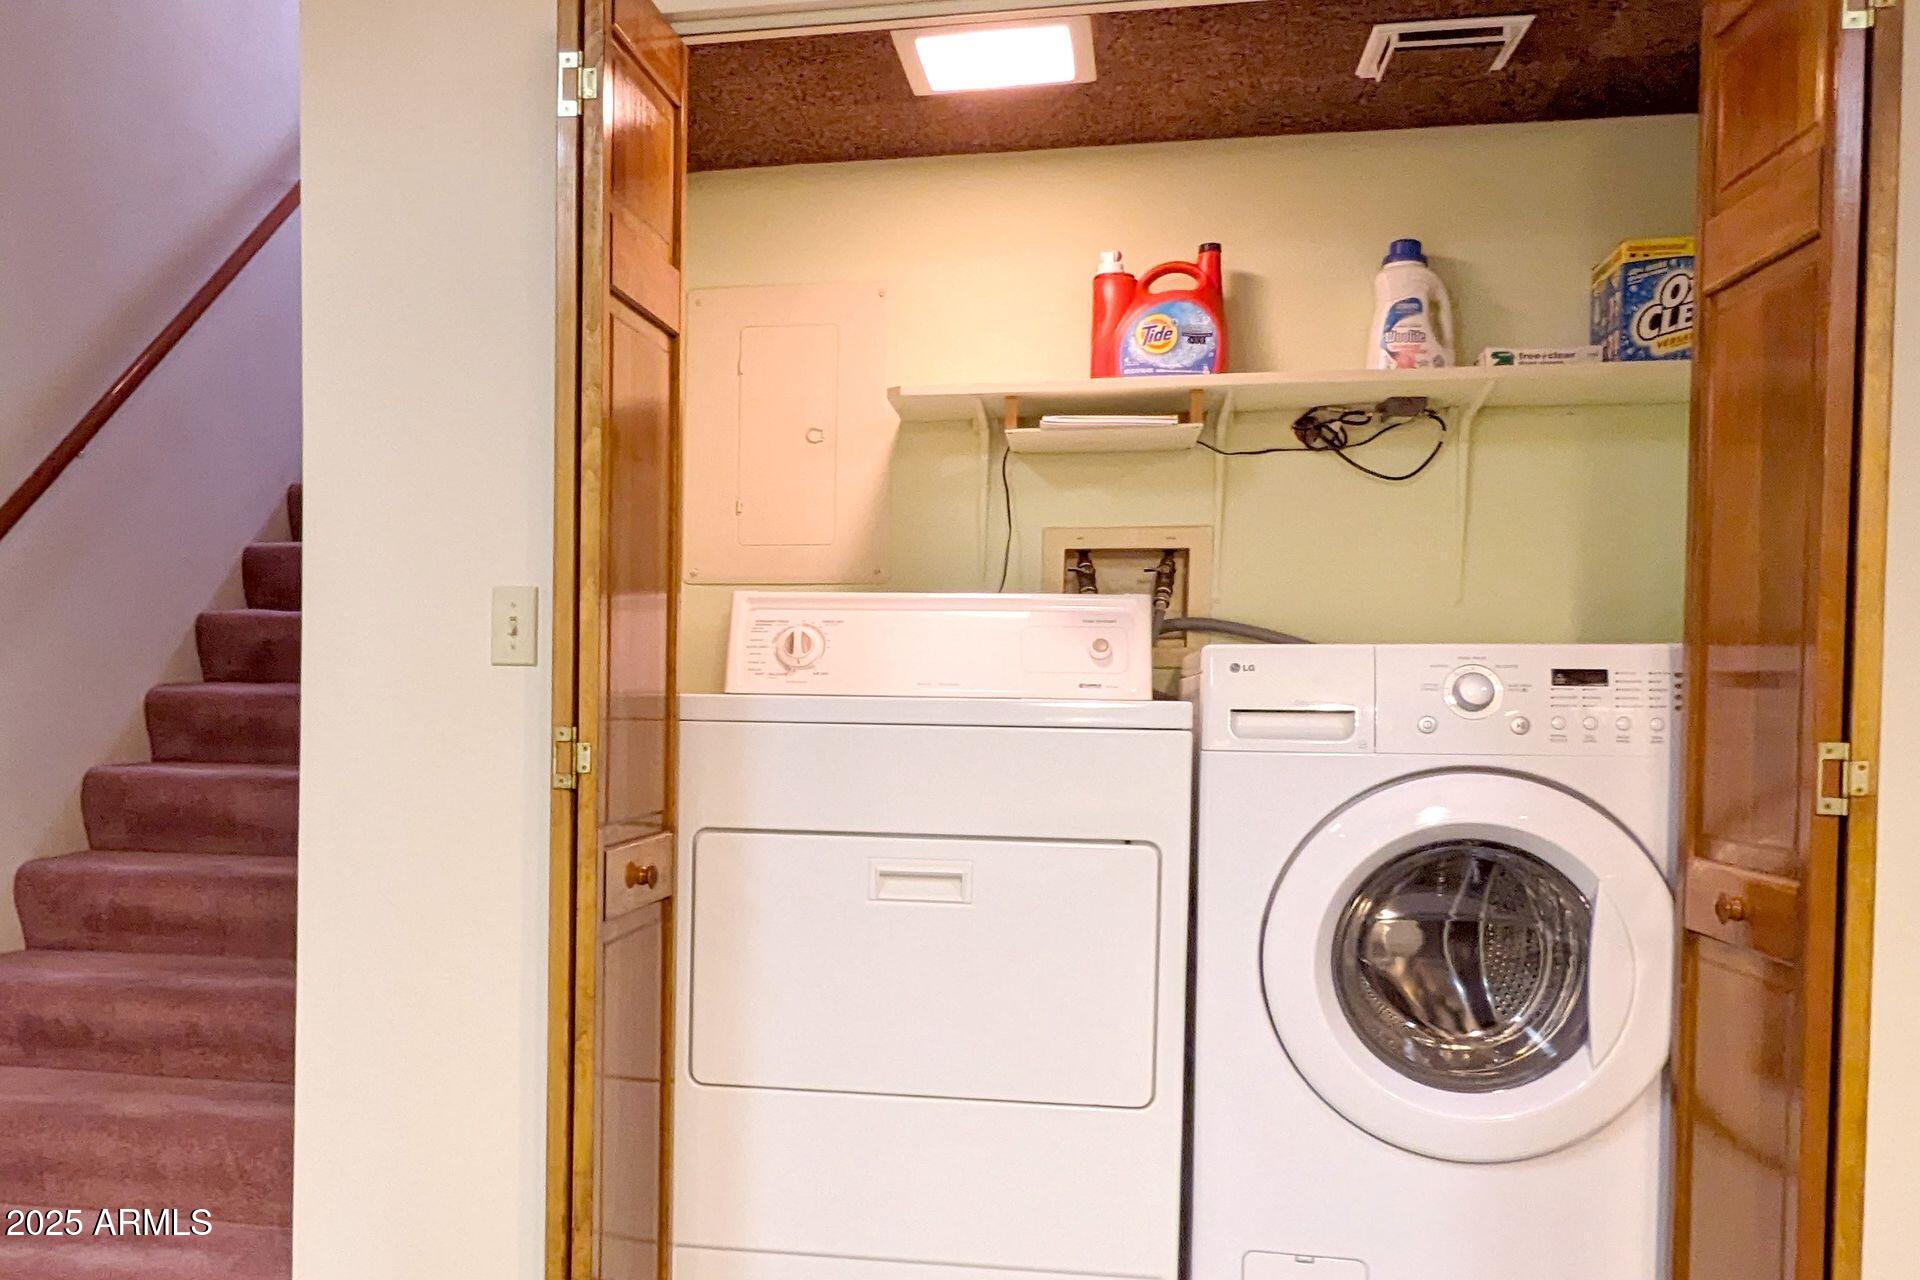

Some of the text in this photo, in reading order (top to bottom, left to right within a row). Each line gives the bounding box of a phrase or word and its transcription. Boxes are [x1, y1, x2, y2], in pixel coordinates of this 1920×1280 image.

[1660, 273, 1693, 309] O
[1637, 303, 1693, 341] CLE
[1142, 325, 1173, 346] Tide
[1385, 330, 1426, 343] Woolite
[1242, 664, 1256, 672] LG
